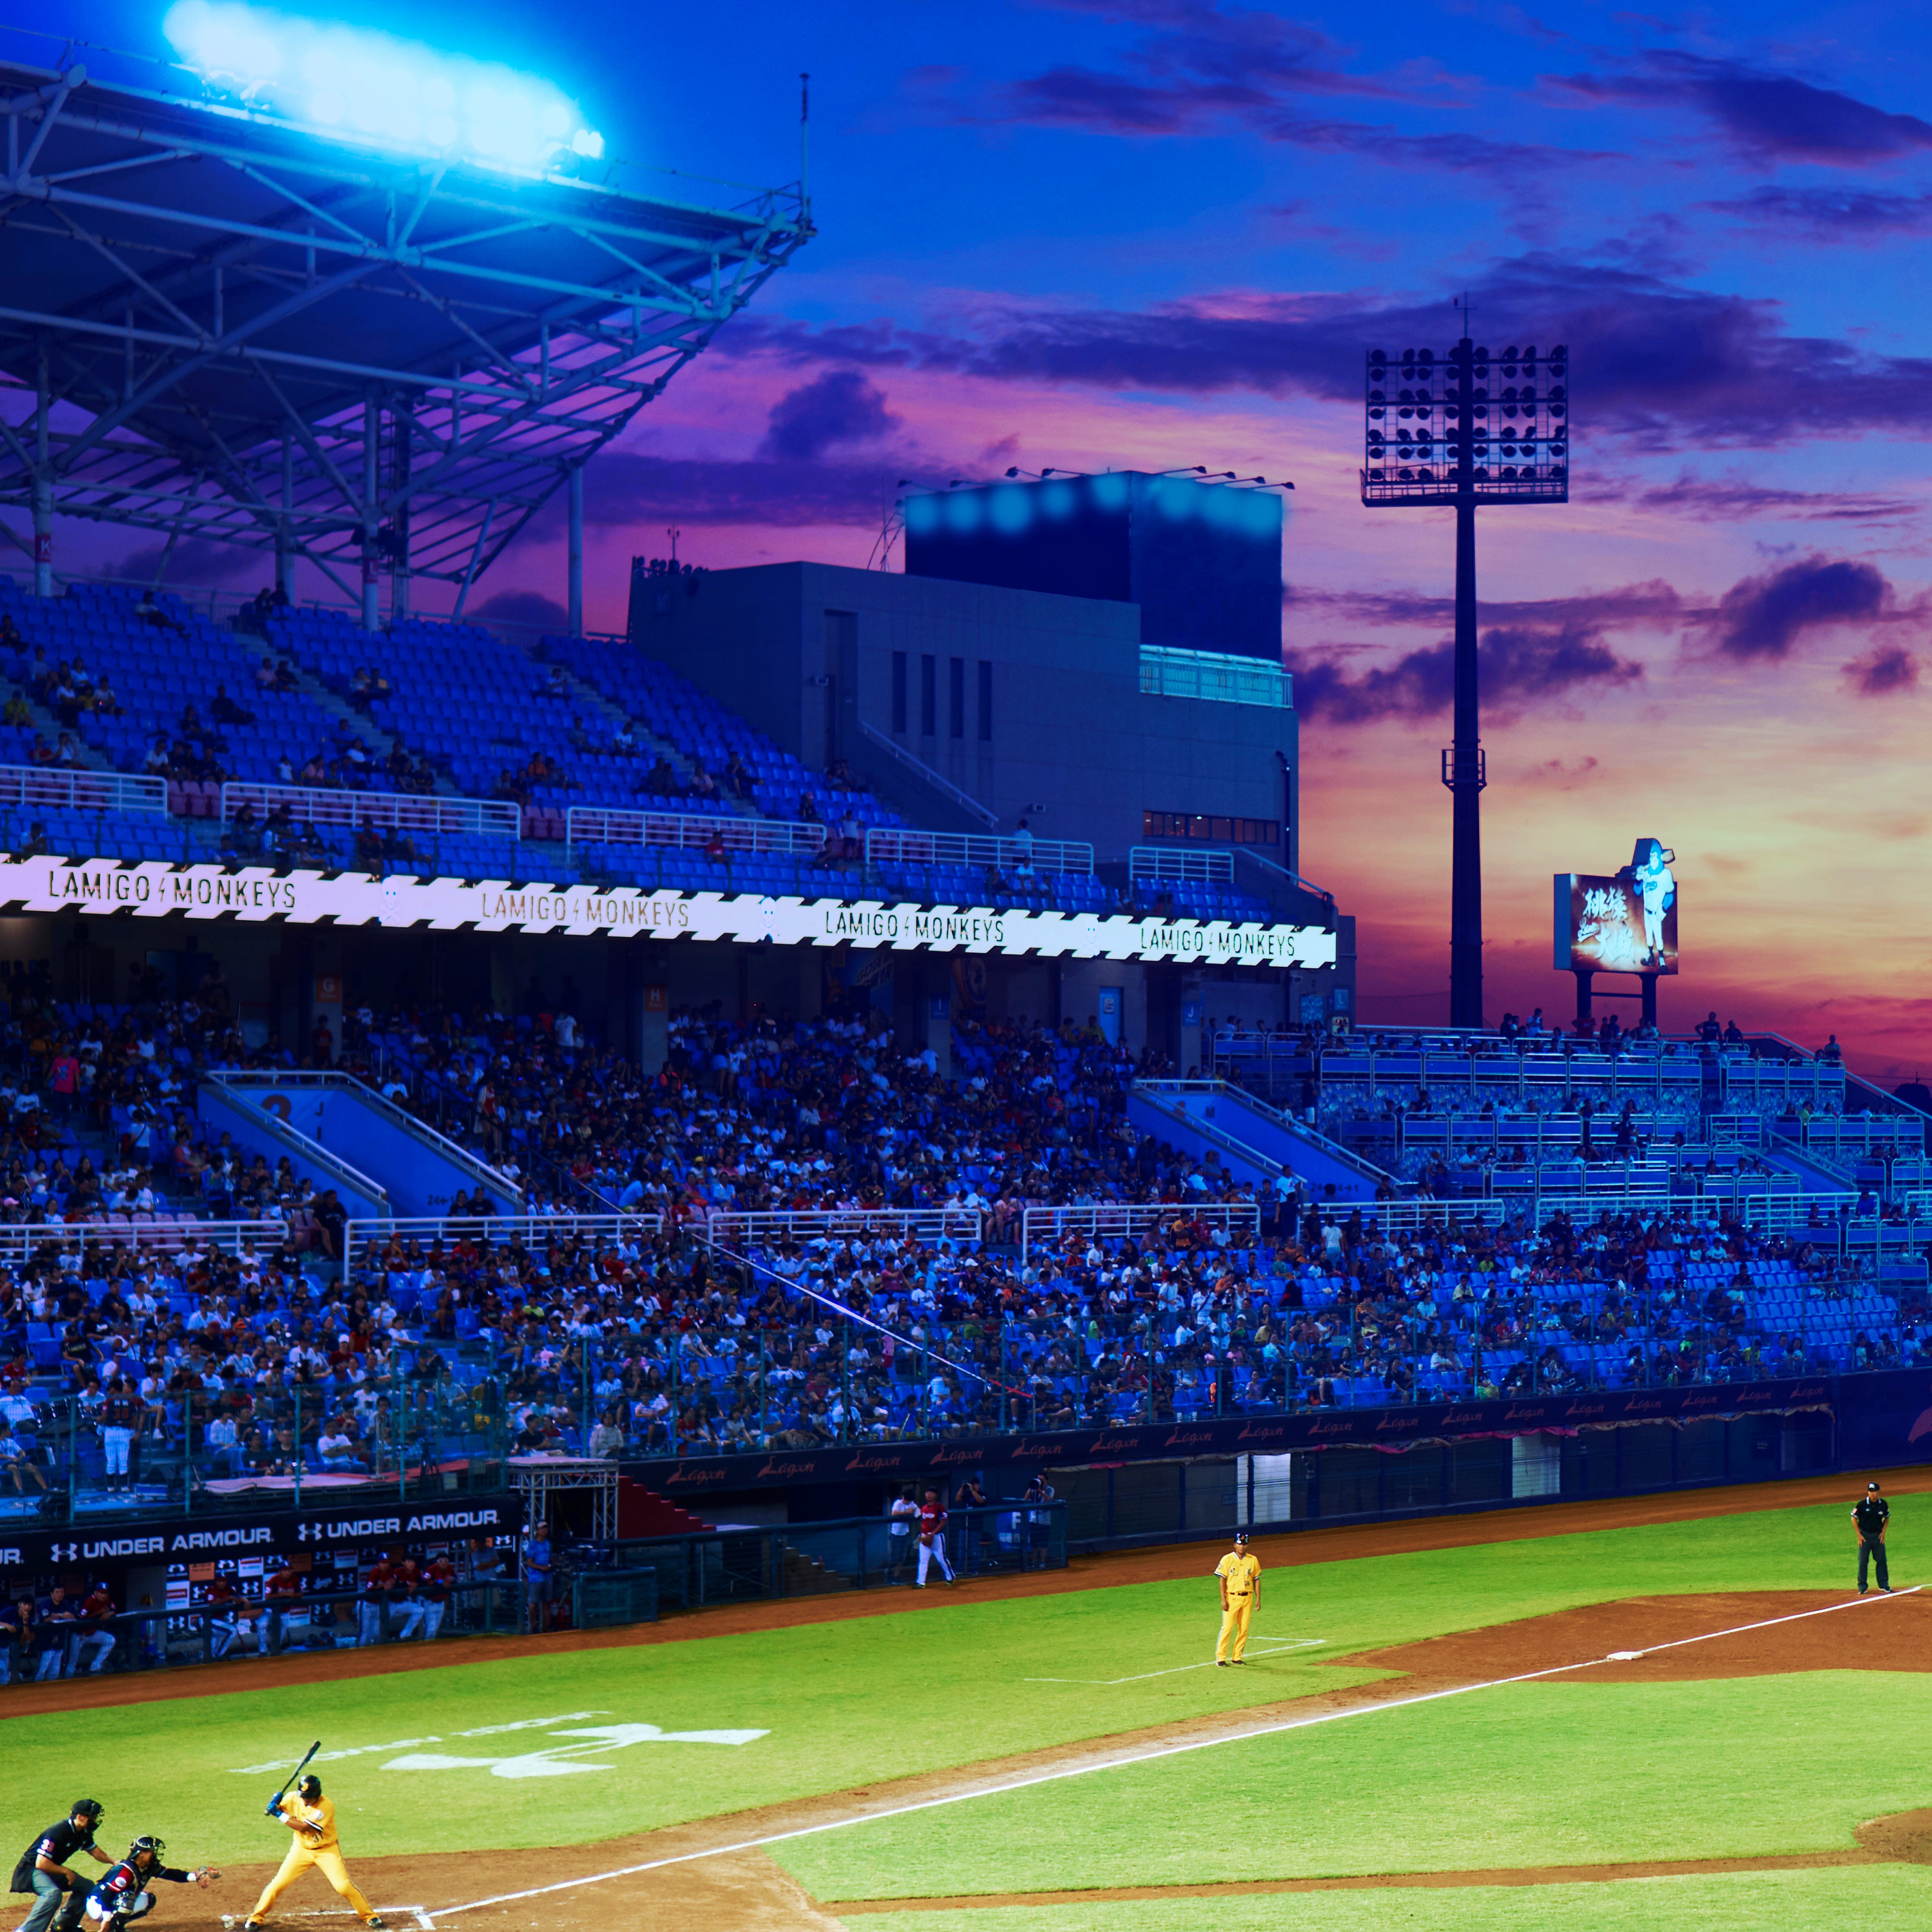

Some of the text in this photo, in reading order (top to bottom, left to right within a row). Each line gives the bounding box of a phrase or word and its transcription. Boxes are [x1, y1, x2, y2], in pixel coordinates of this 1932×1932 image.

[49, 871, 296, 909] LAMIGO MONKEYS
[482, 893, 689, 926] LAMIGO MONKEYS
[826, 911, 1004, 942] LAMIGO MONKEYS
[1141, 928, 1295, 956] LAMIGO MONKEYS
[323, 977, 334, 992] G
[651, 988, 660, 1002] H
[1188, 1006, 1194, 1018] J
[1681, 1389, 1718, 1408] Lagoon
[1736, 1385, 1773, 1402] Lagoon
[1790, 1382, 1824, 1398] Lagoon
[1504, 1402, 1545, 1420] Lagoon
[1565, 1398, 1605, 1415] Lagoon
[1624, 1394, 1662, 1411] Lagoon
[1376, 1411, 1419, 1431] Lagoon
[1442, 1407, 1484, 1426] Lagoon
[1238, 1420, 1284, 1440] Lagoon
[1308, 1417, 1354, 1436] Lagoon
[1090, 1433, 1139, 1452] Lagoon
[1166, 1427, 1213, 1447] Lagoon
[930, 1444, 984, 1465] Lagoon
[1012, 1438, 1063, 1459] Lagoon
[757, 1456, 815, 1478] Lagoon
[846, 1449, 902, 1471] Lagoon
[667, 1462, 725, 1485] Lagoon
[327, 1519, 400, 1538] UNDER
[84, 1537, 164, 1558] UNDER
